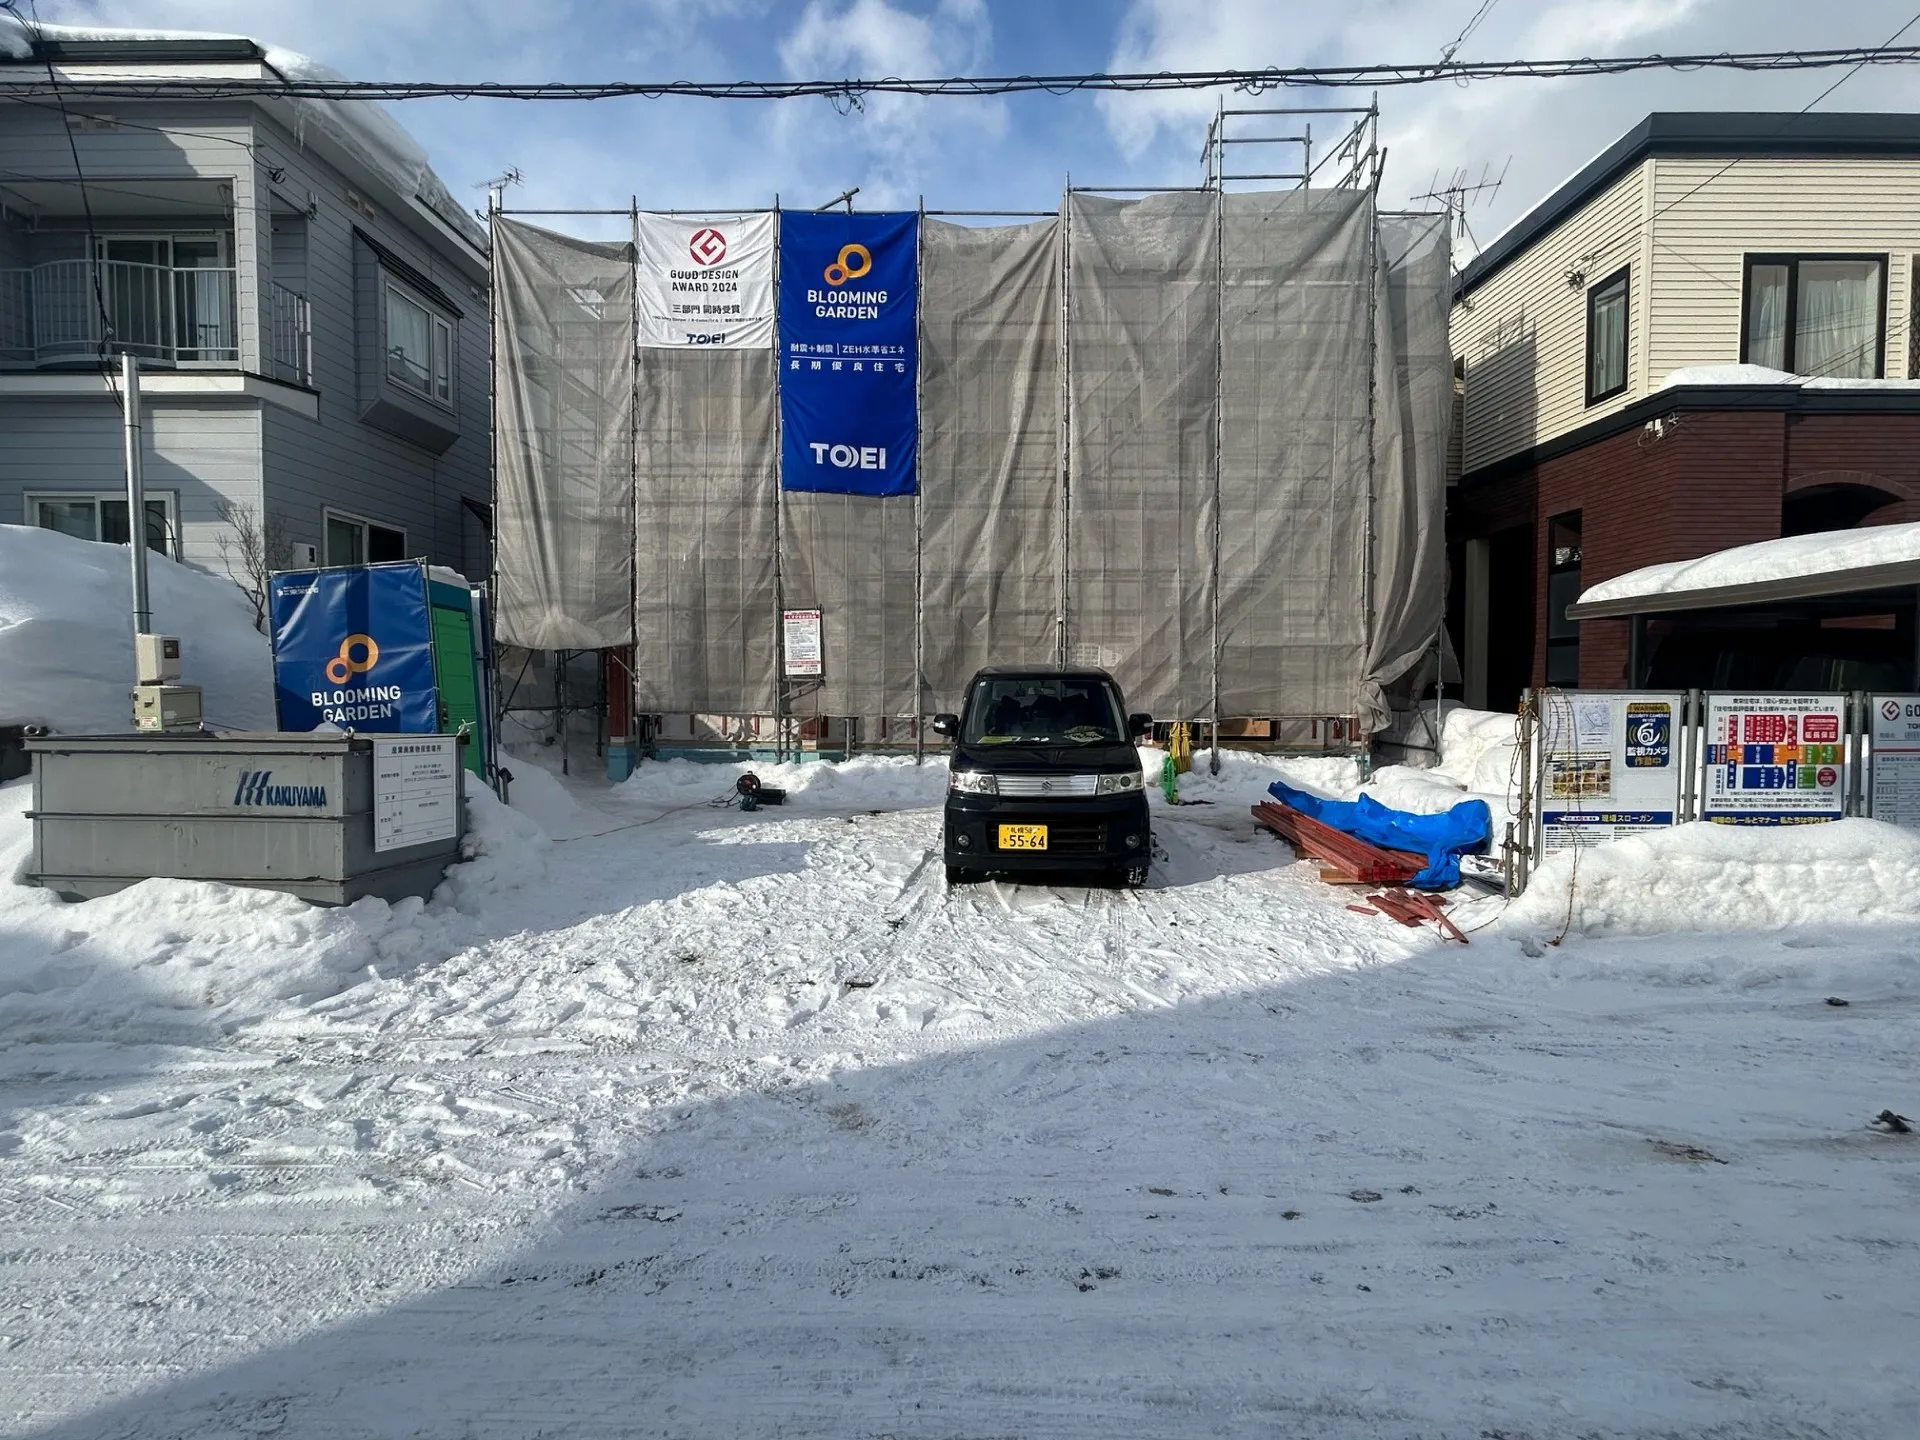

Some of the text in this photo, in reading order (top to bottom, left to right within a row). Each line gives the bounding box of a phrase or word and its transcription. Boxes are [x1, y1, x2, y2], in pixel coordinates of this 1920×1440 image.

[702, 269, 739, 280] DESIGN
[672, 282, 738, 292] AWARD 2024
[808, 290, 888, 304] BLOOMING
[672, 304, 741, 315] 三部門 同時受賞
[815, 305, 878, 320] GARDEN
[790, 360, 905, 373] 長期優良住宅
[809, 442, 886, 470] TOEI
[311, 685, 401, 708] BLOOMING
[322, 703, 392, 723] GARDEN
[1627, 746, 1669, 756] 監視カメラ
[266, 786, 327, 807] KAKUYAMA
[1009, 835, 1044, 848] 55-64
